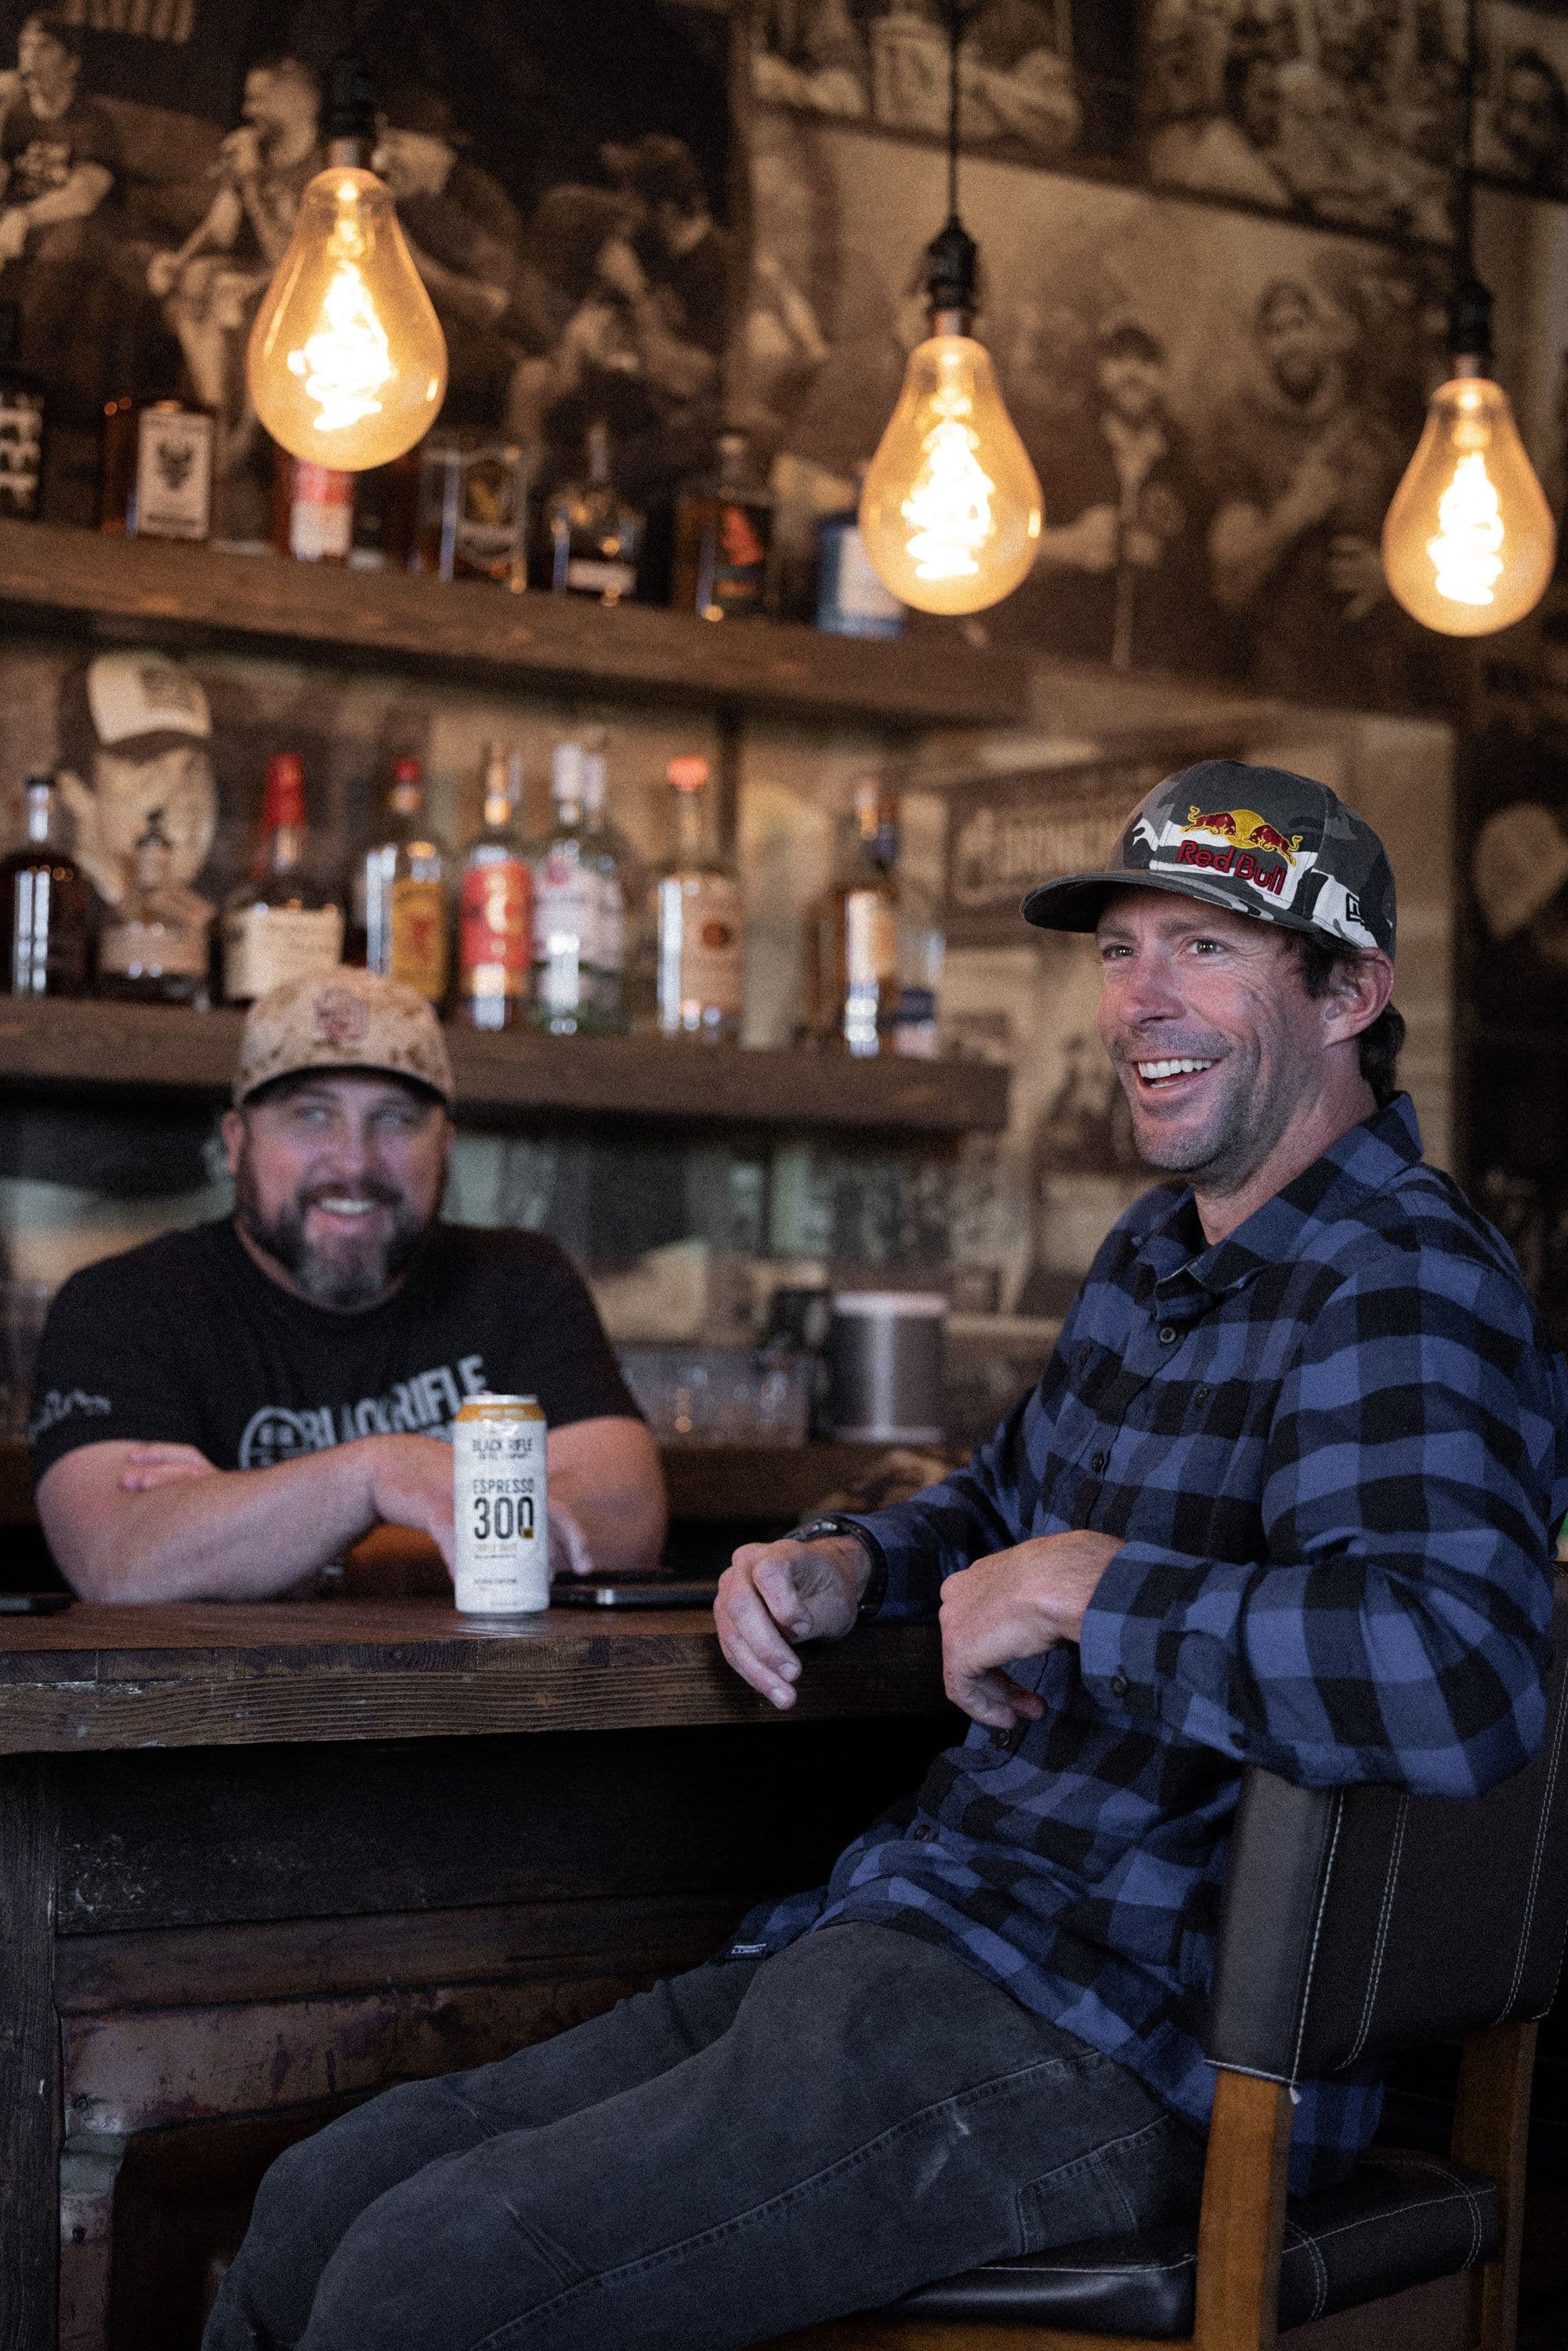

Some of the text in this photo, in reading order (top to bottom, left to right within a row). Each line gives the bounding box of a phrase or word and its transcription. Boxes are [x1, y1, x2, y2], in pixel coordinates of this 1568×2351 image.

[1175, 839, 1287, 896] Red Bull
[473, 1478, 534, 1494] ESPRESSO
[473, 1496, 534, 1540] 300
